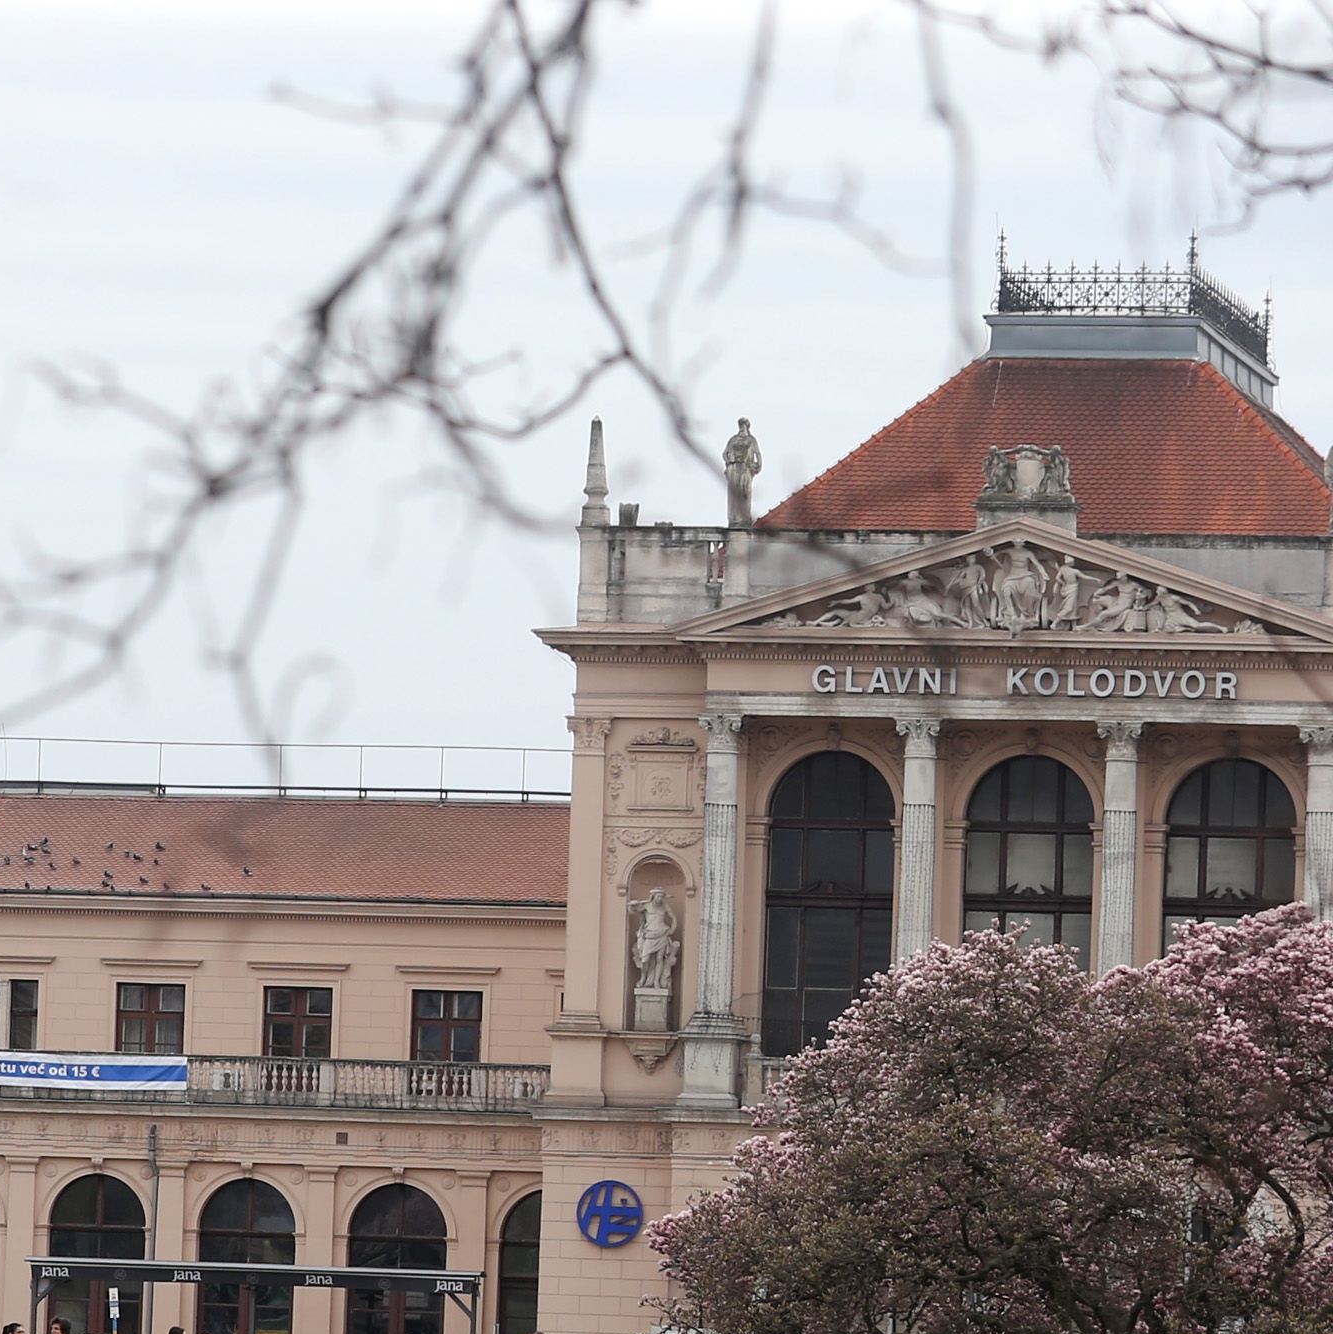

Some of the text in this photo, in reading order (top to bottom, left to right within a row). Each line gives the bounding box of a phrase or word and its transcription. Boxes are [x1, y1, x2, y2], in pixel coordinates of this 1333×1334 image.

[811, 664, 1238, 700] GLAVNI KOLODVOR
[20, 1063, 45, 1075] već
[48, 1065, 67, 1076] od
[72, 1066, 87, 1077] 15
[91, 1066, 100, 1078] €
